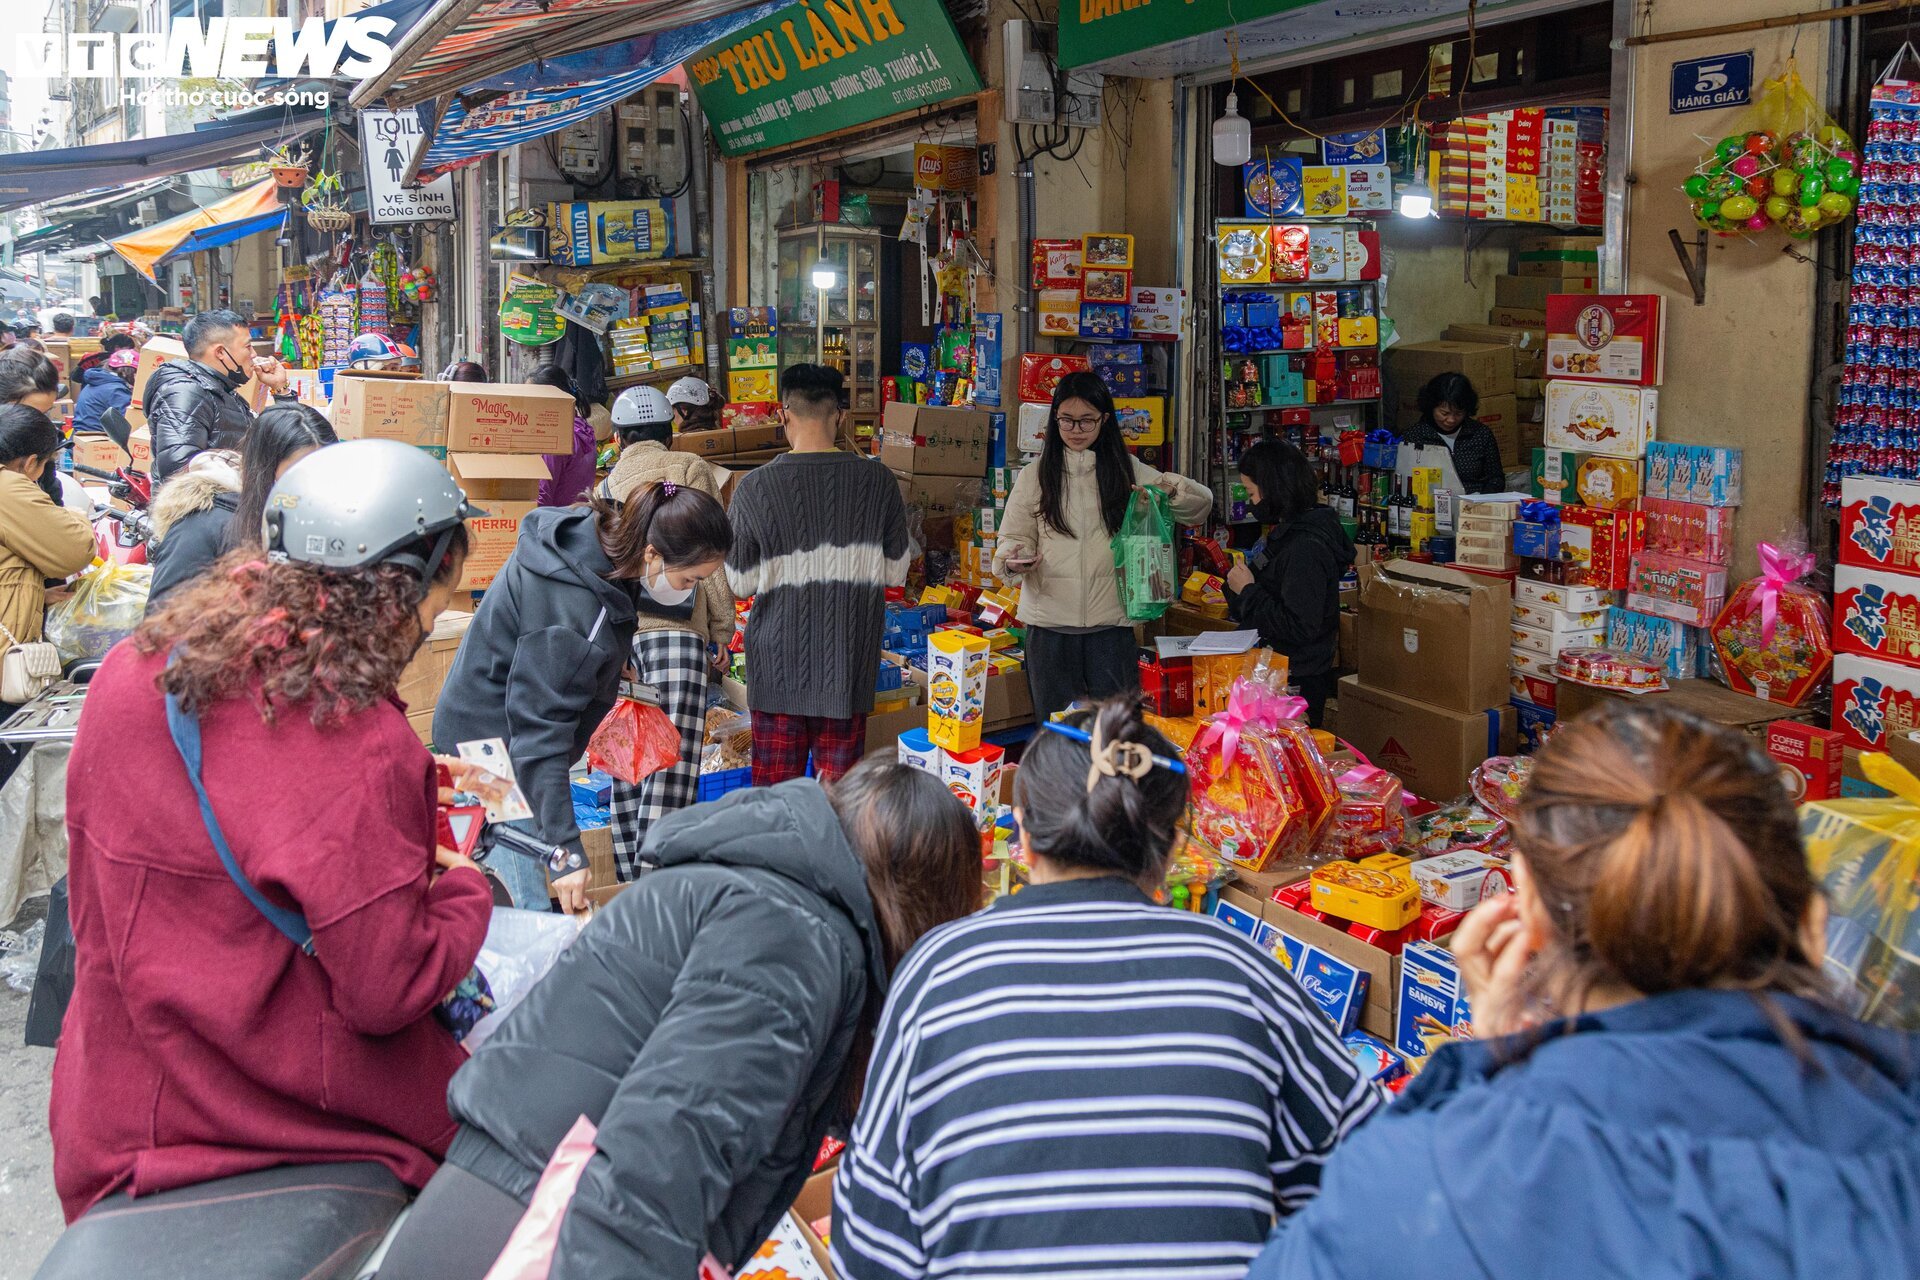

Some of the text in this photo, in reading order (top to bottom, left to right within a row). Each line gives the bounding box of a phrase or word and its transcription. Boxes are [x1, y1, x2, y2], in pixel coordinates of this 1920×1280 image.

[718, 29, 787, 95] THU
[813, 85, 832, 106] BIA
[830, 74, 865, 100] ĐƯỜNG
[861, 64, 886, 90] SỮA
[884, 48, 924, 83] THUỐC
[920, 43, 942, 72] LÁ
[1694, 63, 1728, 92] 5
[918, 84, 933, 97] 615
[931, 76, 952, 93] 0299
[1677, 87, 1744, 108] HÀNG GIẤY
[919, 156, 943, 174] Lay's
[1347, 184, 1372, 192] Zuccheri
[409, 193, 444, 202] SINH
[378, 205, 414, 217] CÔNG
[574, 210, 590, 259] HALIDA
[635, 211, 649, 250] HALIDA
[1132, 305, 1159, 314] Zuccheri
[471, 398, 508, 418] Magic
[505, 410, 529, 426] Mix
[1648, 455, 1669, 465] Tcky
[1670, 456, 1691, 467] Tcky
[1693, 460, 1713, 468] Tcky
[471, 518, 517, 533] MERRY
[1894, 539, 1920, 549] HORS
[1770, 734, 1805, 749] COFFEE
[1770, 744, 1805, 757] JORDAN
[1408, 986, 1447, 1014] БАМБУК
